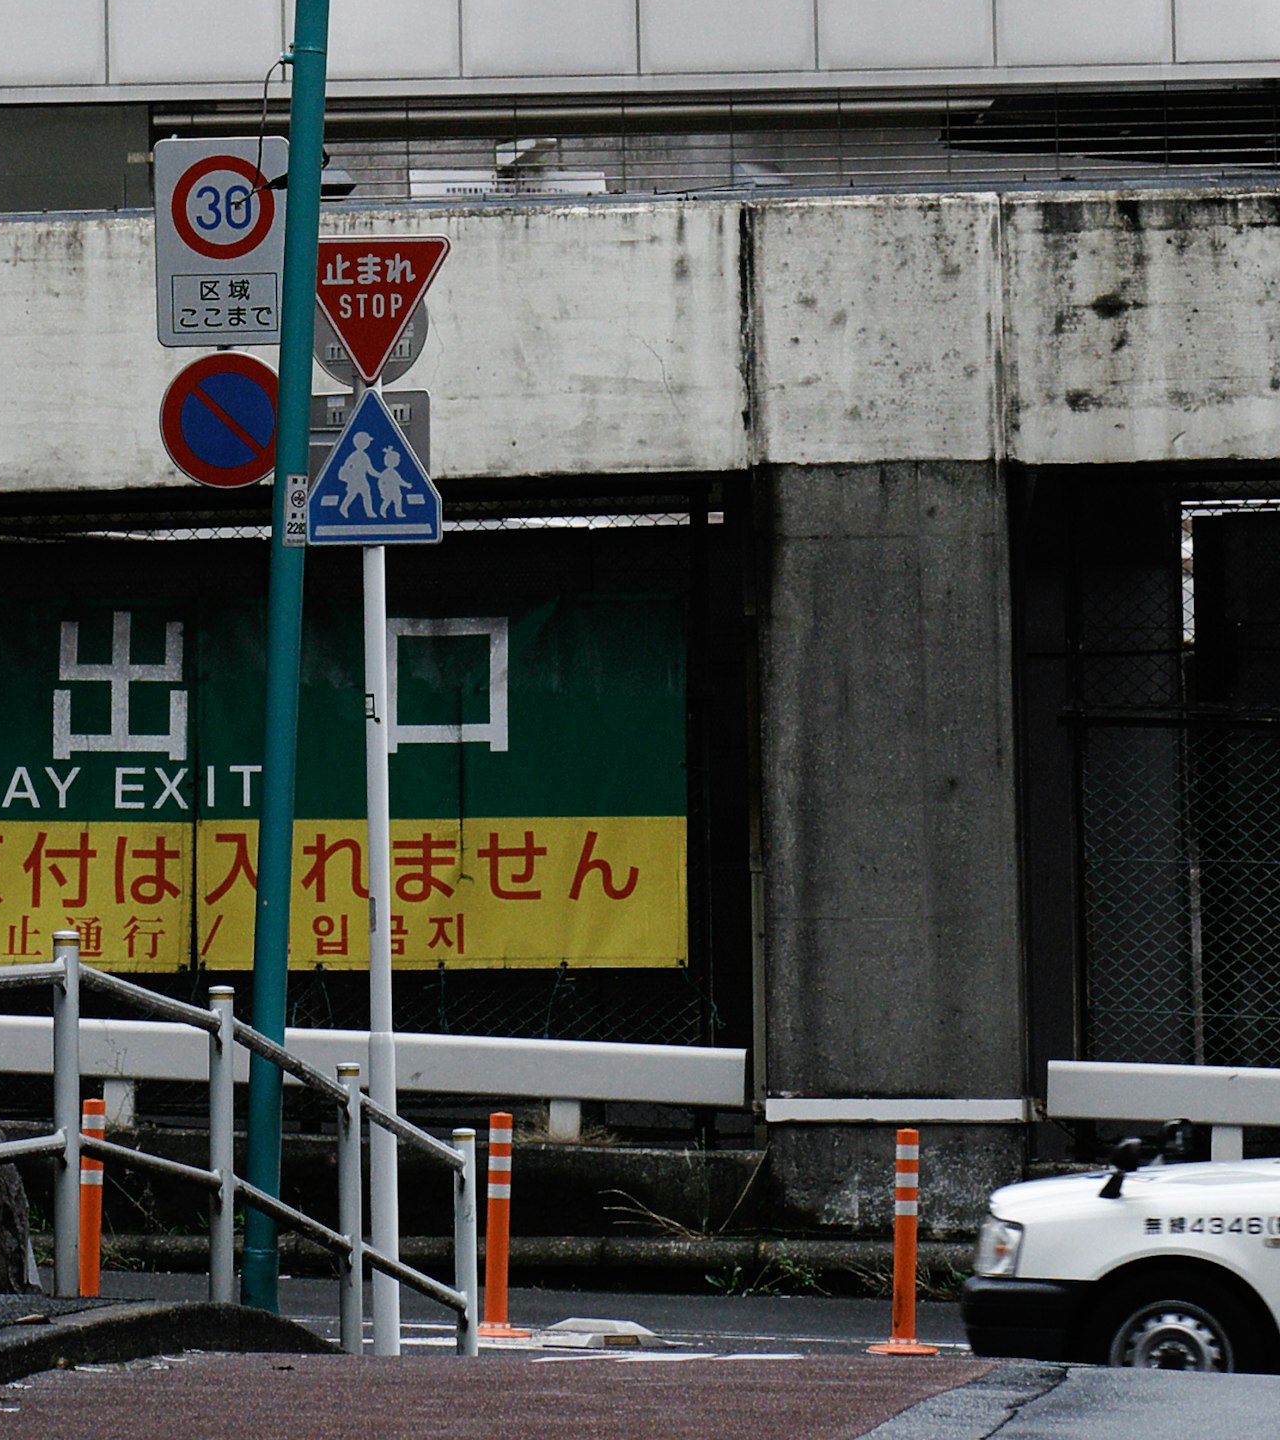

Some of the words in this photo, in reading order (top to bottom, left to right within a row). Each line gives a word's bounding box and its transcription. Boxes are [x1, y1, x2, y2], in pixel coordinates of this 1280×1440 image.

[195, 184, 252, 231] 30
[320, 252, 417, 286] 止まれ
[199, 278, 250, 301] 区域
[338, 292, 403, 319] STOP
[179, 305, 273, 328] ここまで
[53, 610, 509, 760] 出口
[114, 765, 263, 809] EXIT
[287, 913, 465, 956] 입지
